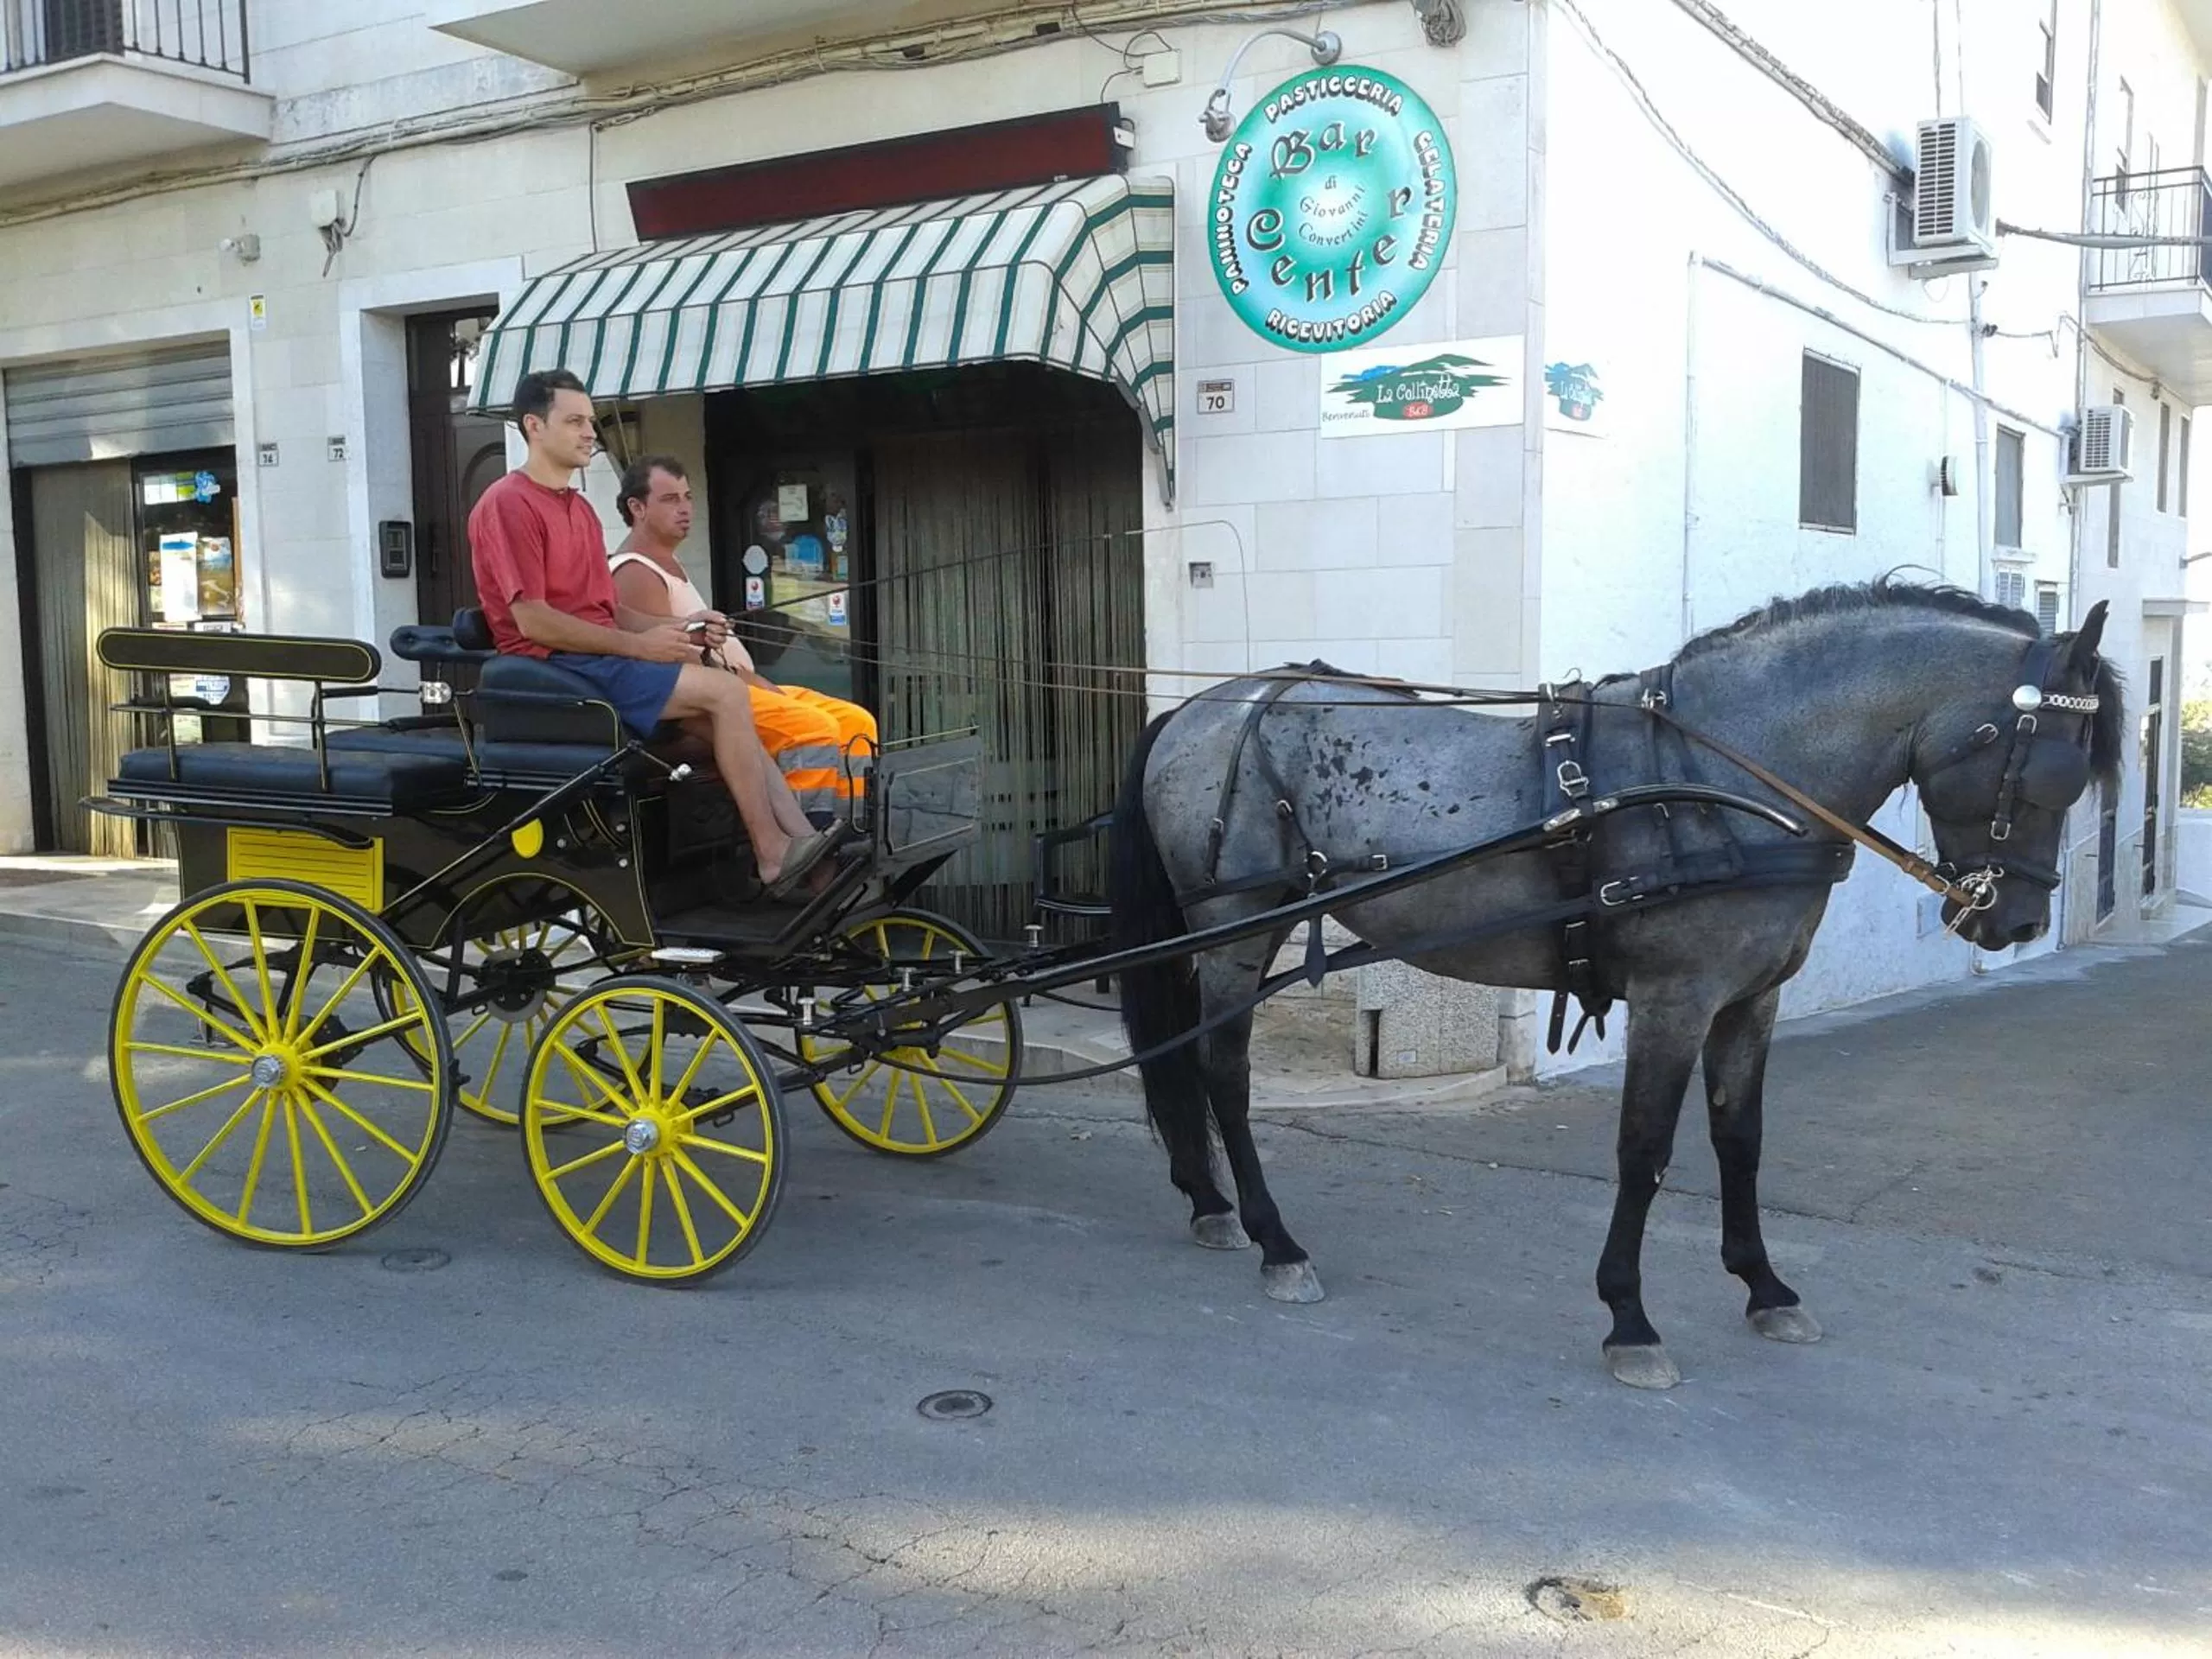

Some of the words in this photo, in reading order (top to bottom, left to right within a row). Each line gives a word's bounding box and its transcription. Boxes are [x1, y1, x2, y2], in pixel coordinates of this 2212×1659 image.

[1263, 74, 1403, 123] PASTICCERIA
[1269, 122, 1376, 180] Bar
[1300, 184, 1366, 218] Giovanni
[1325, 175, 1338, 190] di
[1408, 130, 1446, 270] GELATERIA
[1246, 185, 1412, 302] Center
[1265, 289, 1397, 342] RICEVITORIA
[1205, 395, 1225, 410] 70
